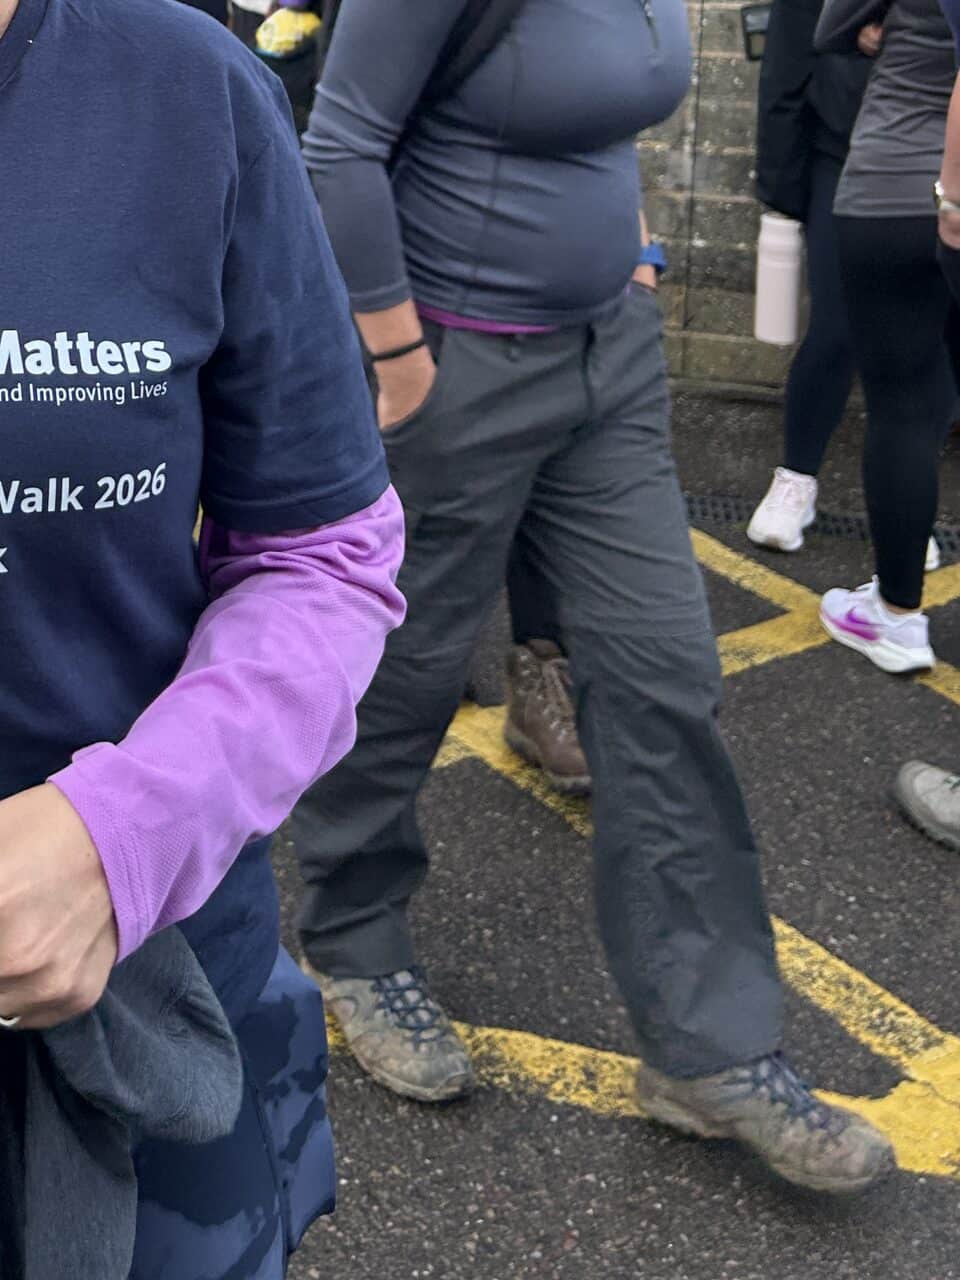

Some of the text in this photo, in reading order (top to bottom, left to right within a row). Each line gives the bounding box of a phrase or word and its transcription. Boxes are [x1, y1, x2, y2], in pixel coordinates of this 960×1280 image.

[29, 382, 125, 407] Improving
[131, 380, 168, 399] Lives
[96, 463, 167, 511] 2026
